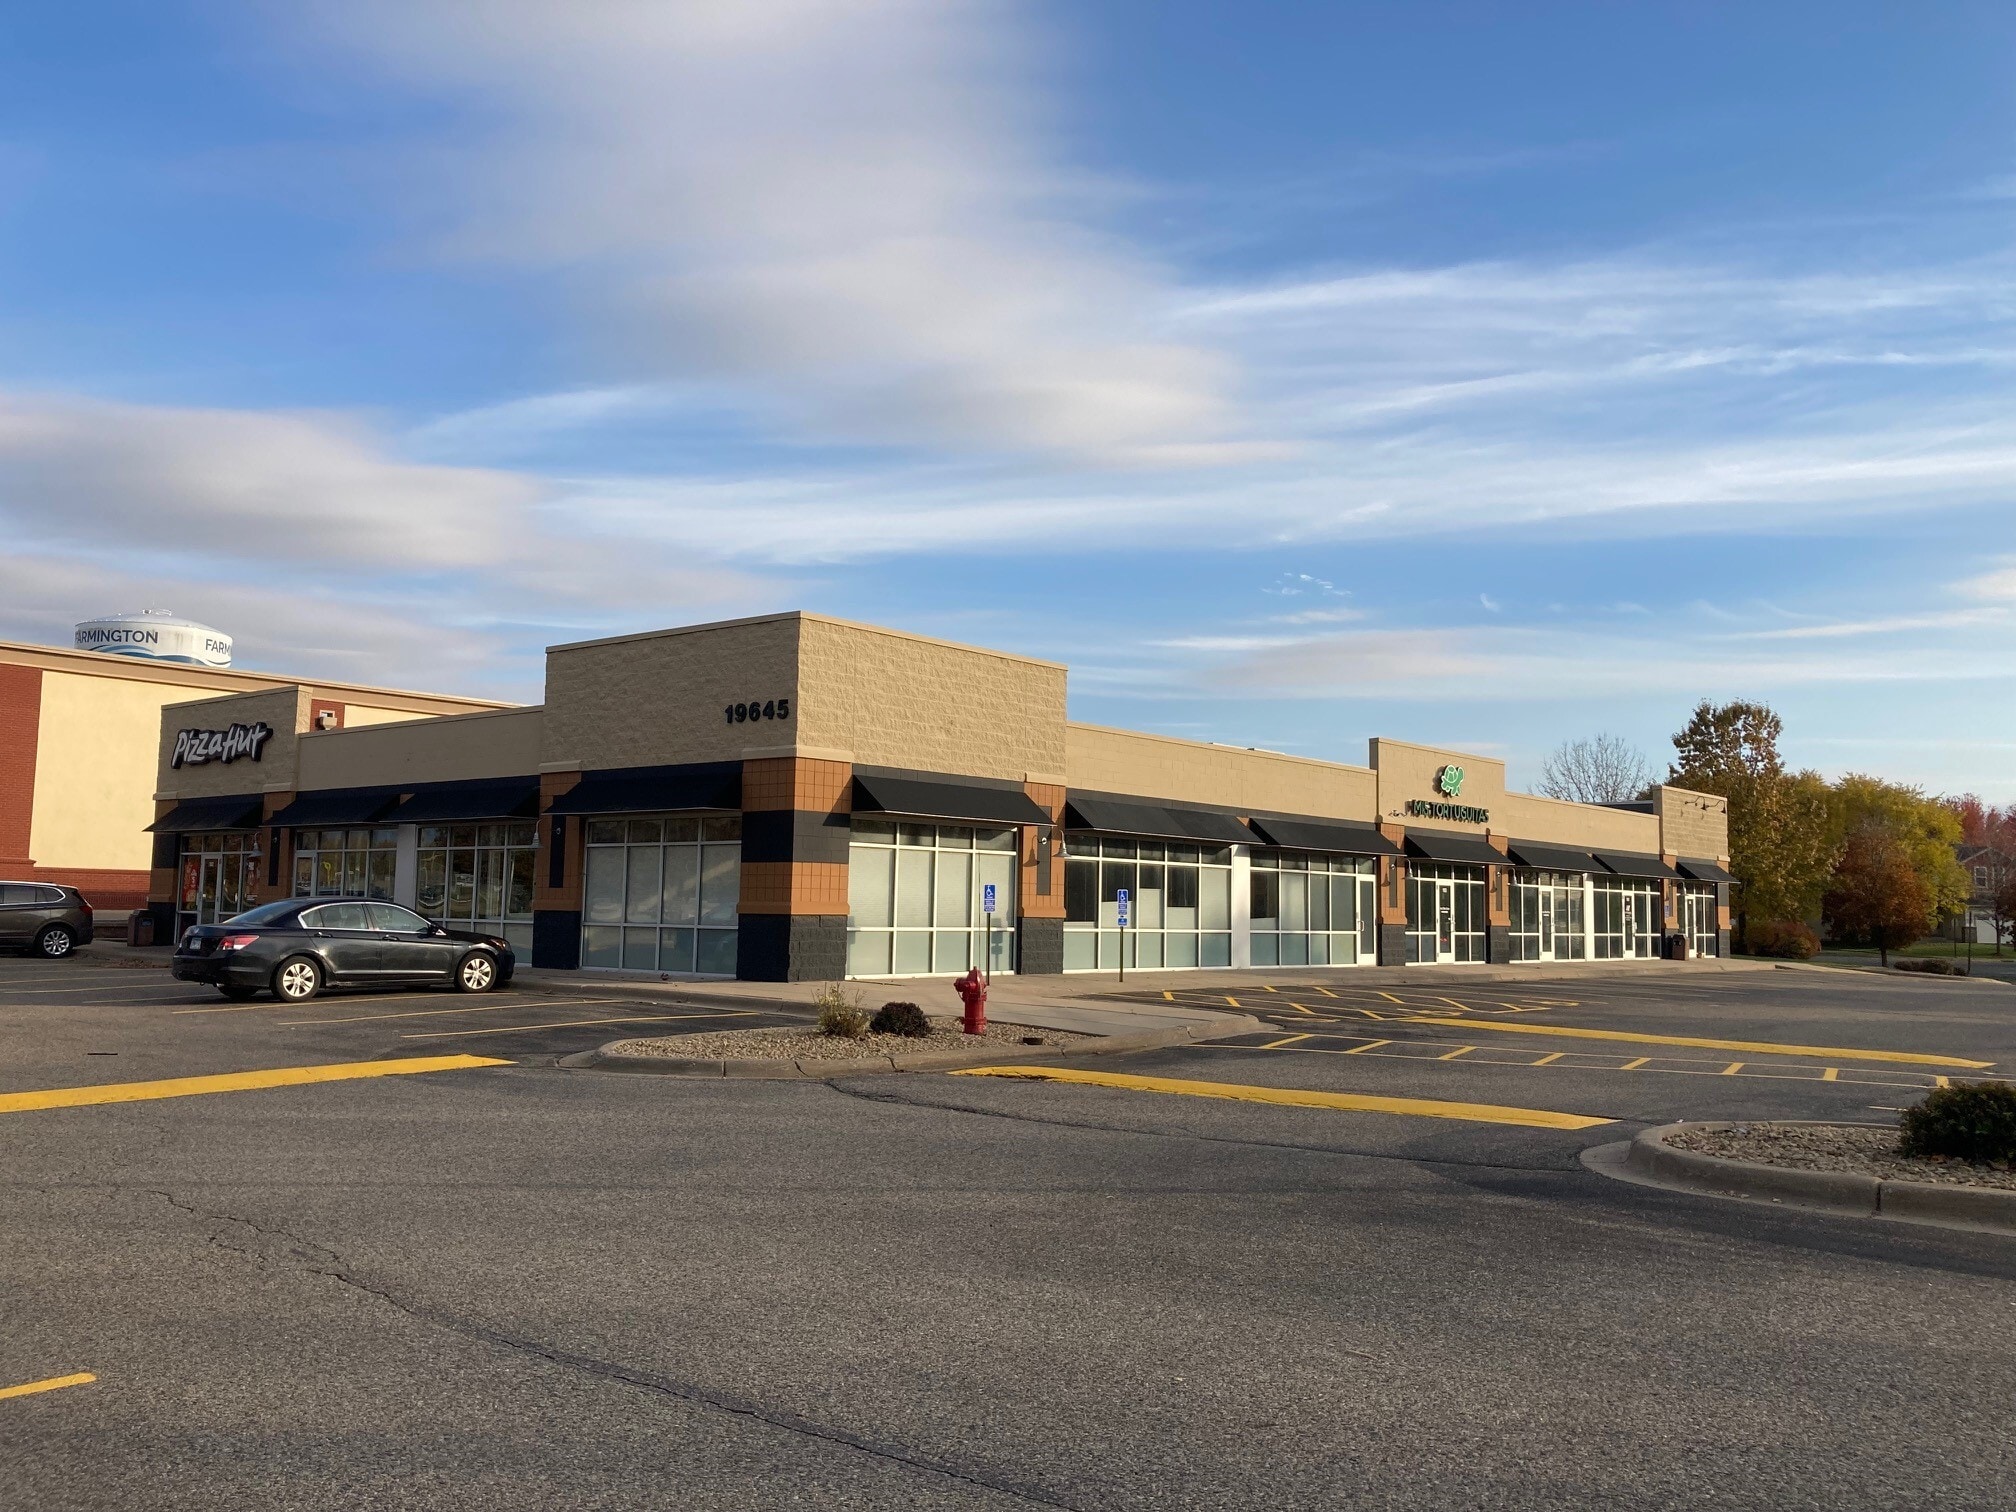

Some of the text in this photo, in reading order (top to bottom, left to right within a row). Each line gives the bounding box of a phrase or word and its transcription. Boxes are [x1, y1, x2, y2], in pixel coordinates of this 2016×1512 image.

[725, 699, 789, 724] 19645
[171, 722, 272, 769] Pizza Hut
[1431, 802, 1489, 823] TORTUGUITAS
